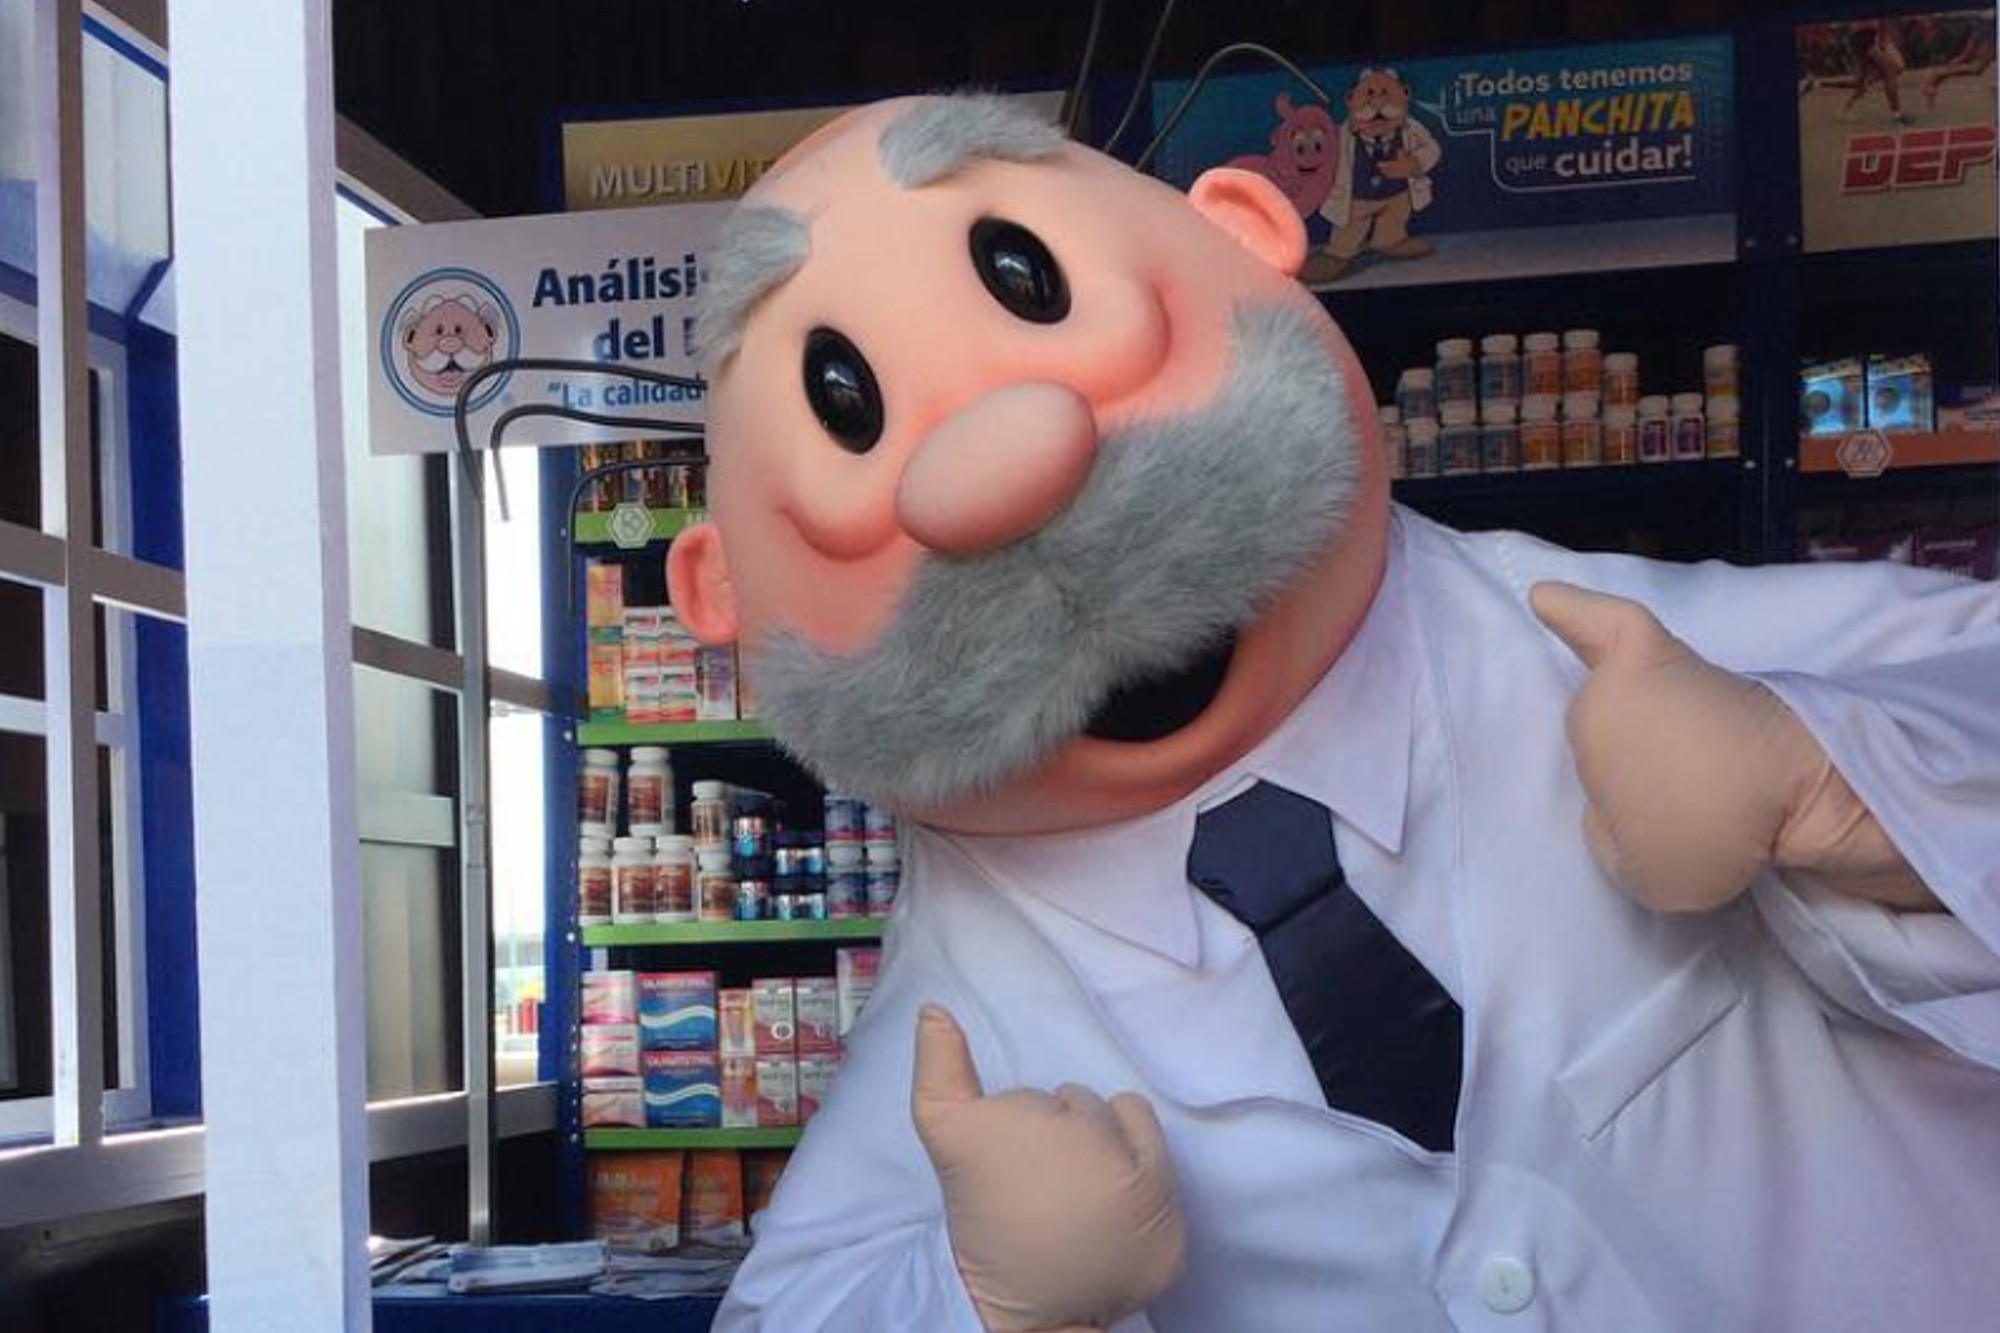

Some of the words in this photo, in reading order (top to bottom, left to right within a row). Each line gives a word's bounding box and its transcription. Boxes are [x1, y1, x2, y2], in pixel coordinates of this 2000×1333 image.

[1454, 68, 1550, 104] ¡Todos
[1558, 63, 1693, 91] tenemos
[1456, 107, 1494, 124] una
[1500, 90, 1696, 140] PANCHITA
[1506, 152, 1547, 175] que
[1554, 134, 1693, 177] cuidar!
[533, 253, 709, 307] Análisi
[594, 315, 665, 362] del
[603, 371, 703, 406] calidad
